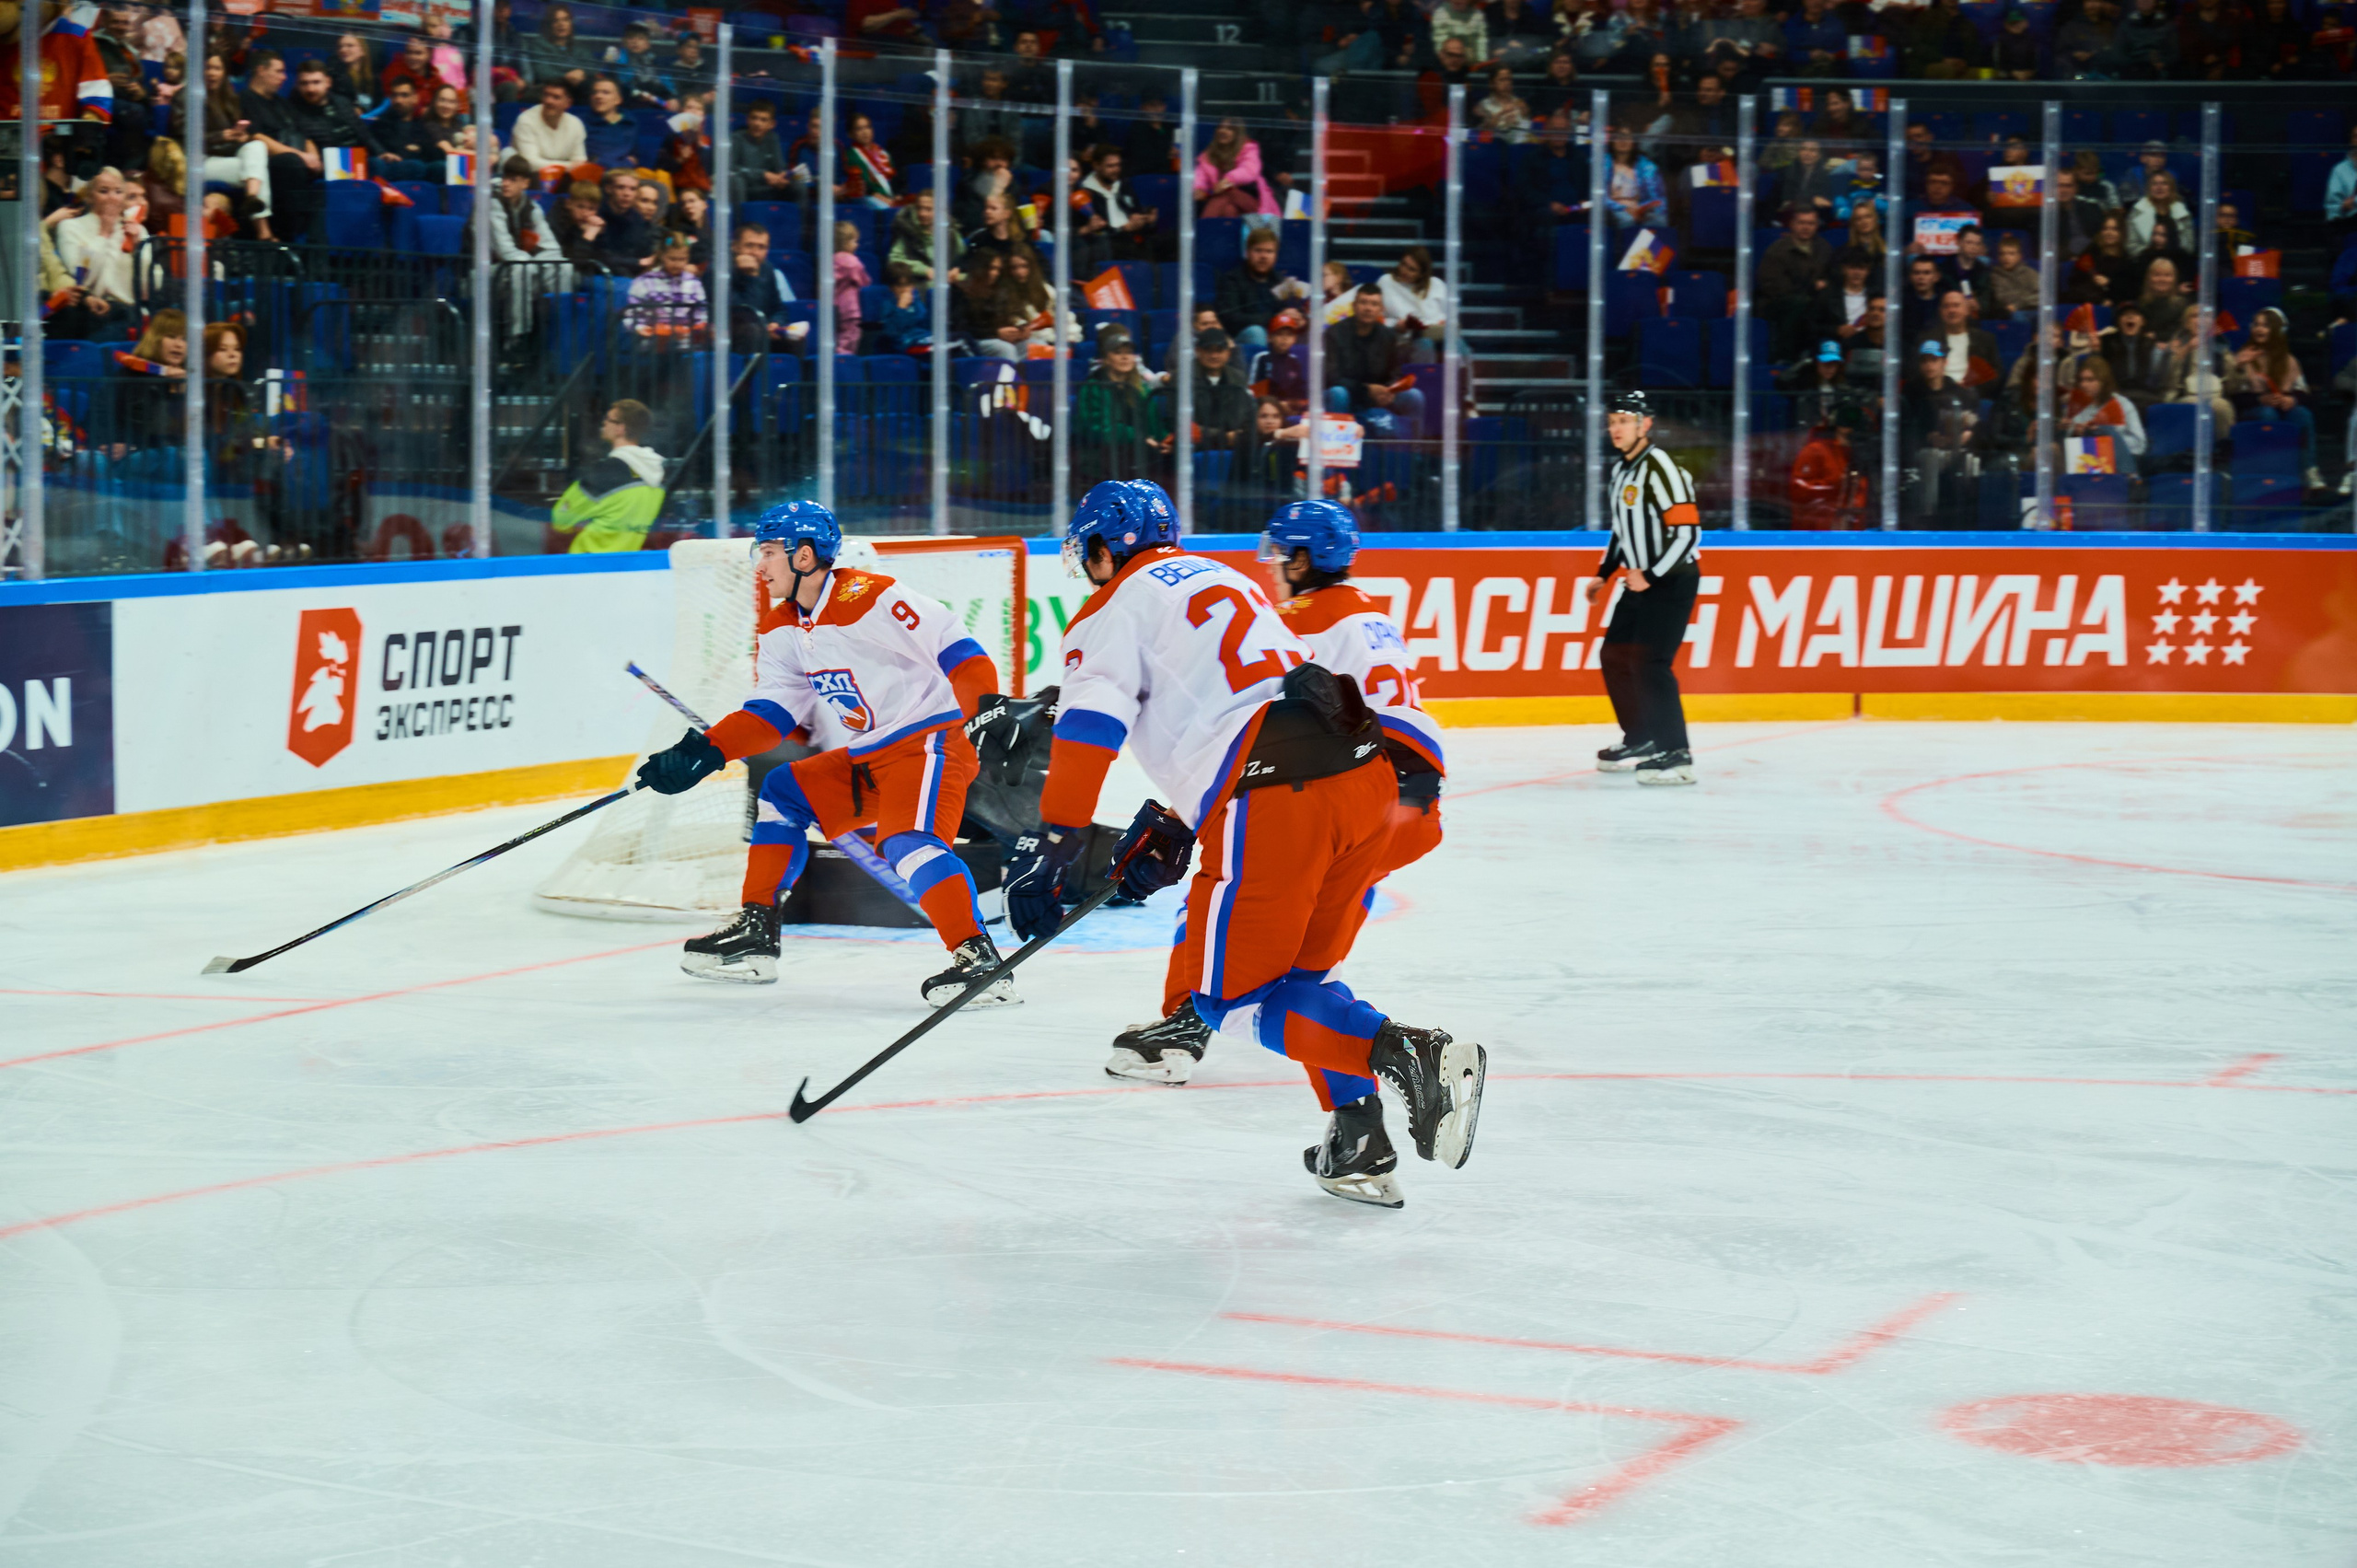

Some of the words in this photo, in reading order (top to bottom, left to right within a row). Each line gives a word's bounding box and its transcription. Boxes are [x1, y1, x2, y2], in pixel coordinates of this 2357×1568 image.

[1215, 24, 1240, 44] 12
[891, 600, 921, 631] 9
[1735, 575, 2128, 668] МАШИНА
[382, 625, 521, 691] СПОРТ
[377, 694, 514, 740] ЭКСПРЕСС
